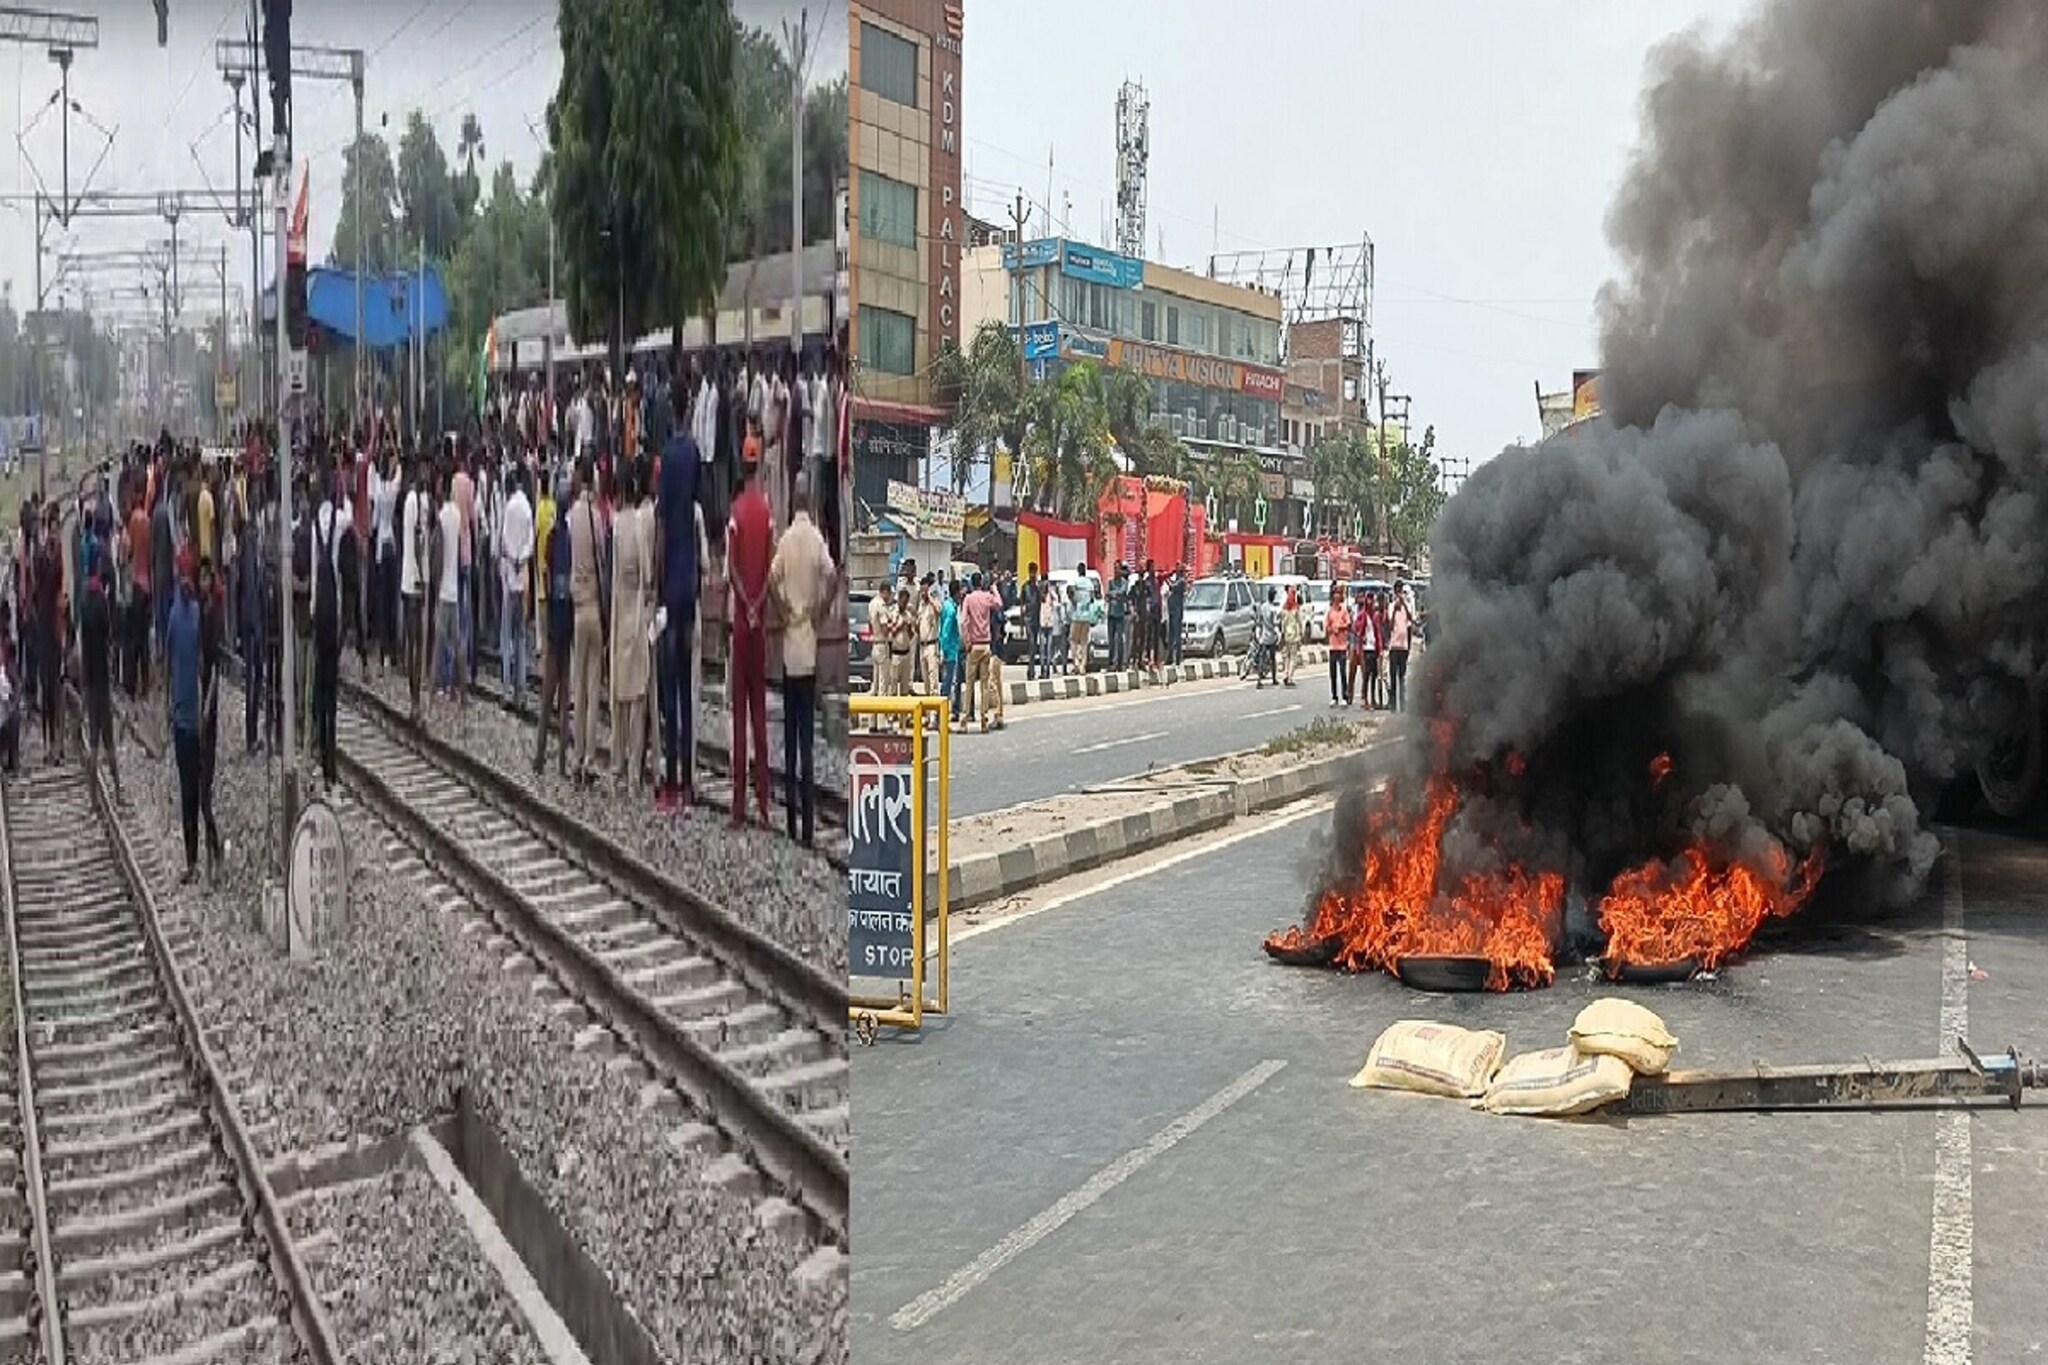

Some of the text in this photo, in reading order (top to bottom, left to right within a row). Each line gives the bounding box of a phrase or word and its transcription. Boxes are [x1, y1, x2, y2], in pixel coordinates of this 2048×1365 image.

[941, 71, 954, 153] KDM
[1122, 342, 1236, 389] ADITYA VISION
[1245, 371, 1279, 390] HITACHI
